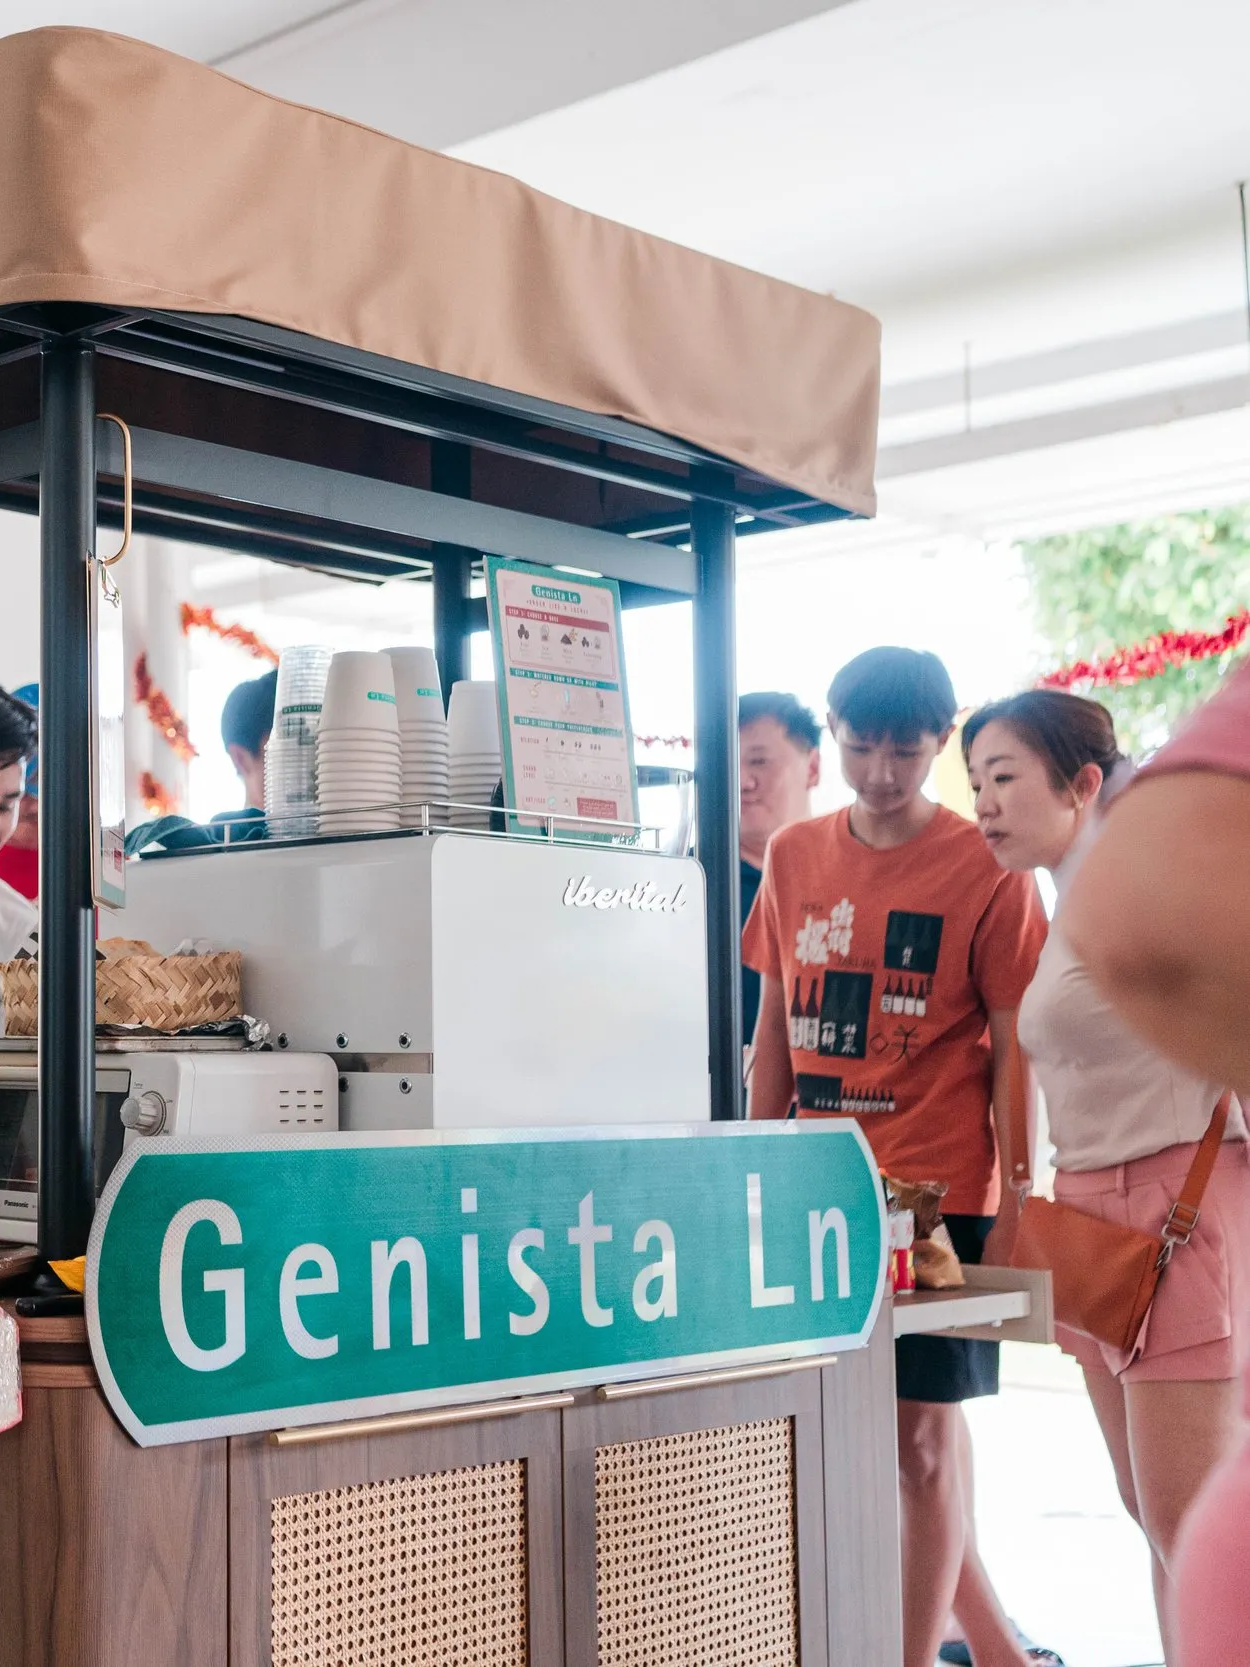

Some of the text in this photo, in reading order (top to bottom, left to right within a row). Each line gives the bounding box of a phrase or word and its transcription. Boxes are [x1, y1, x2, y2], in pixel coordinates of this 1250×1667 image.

[535, 586, 578, 602] Genista Ln
[562, 874, 688, 913] iberital
[159, 1173, 851, 1372] Genista Ln
